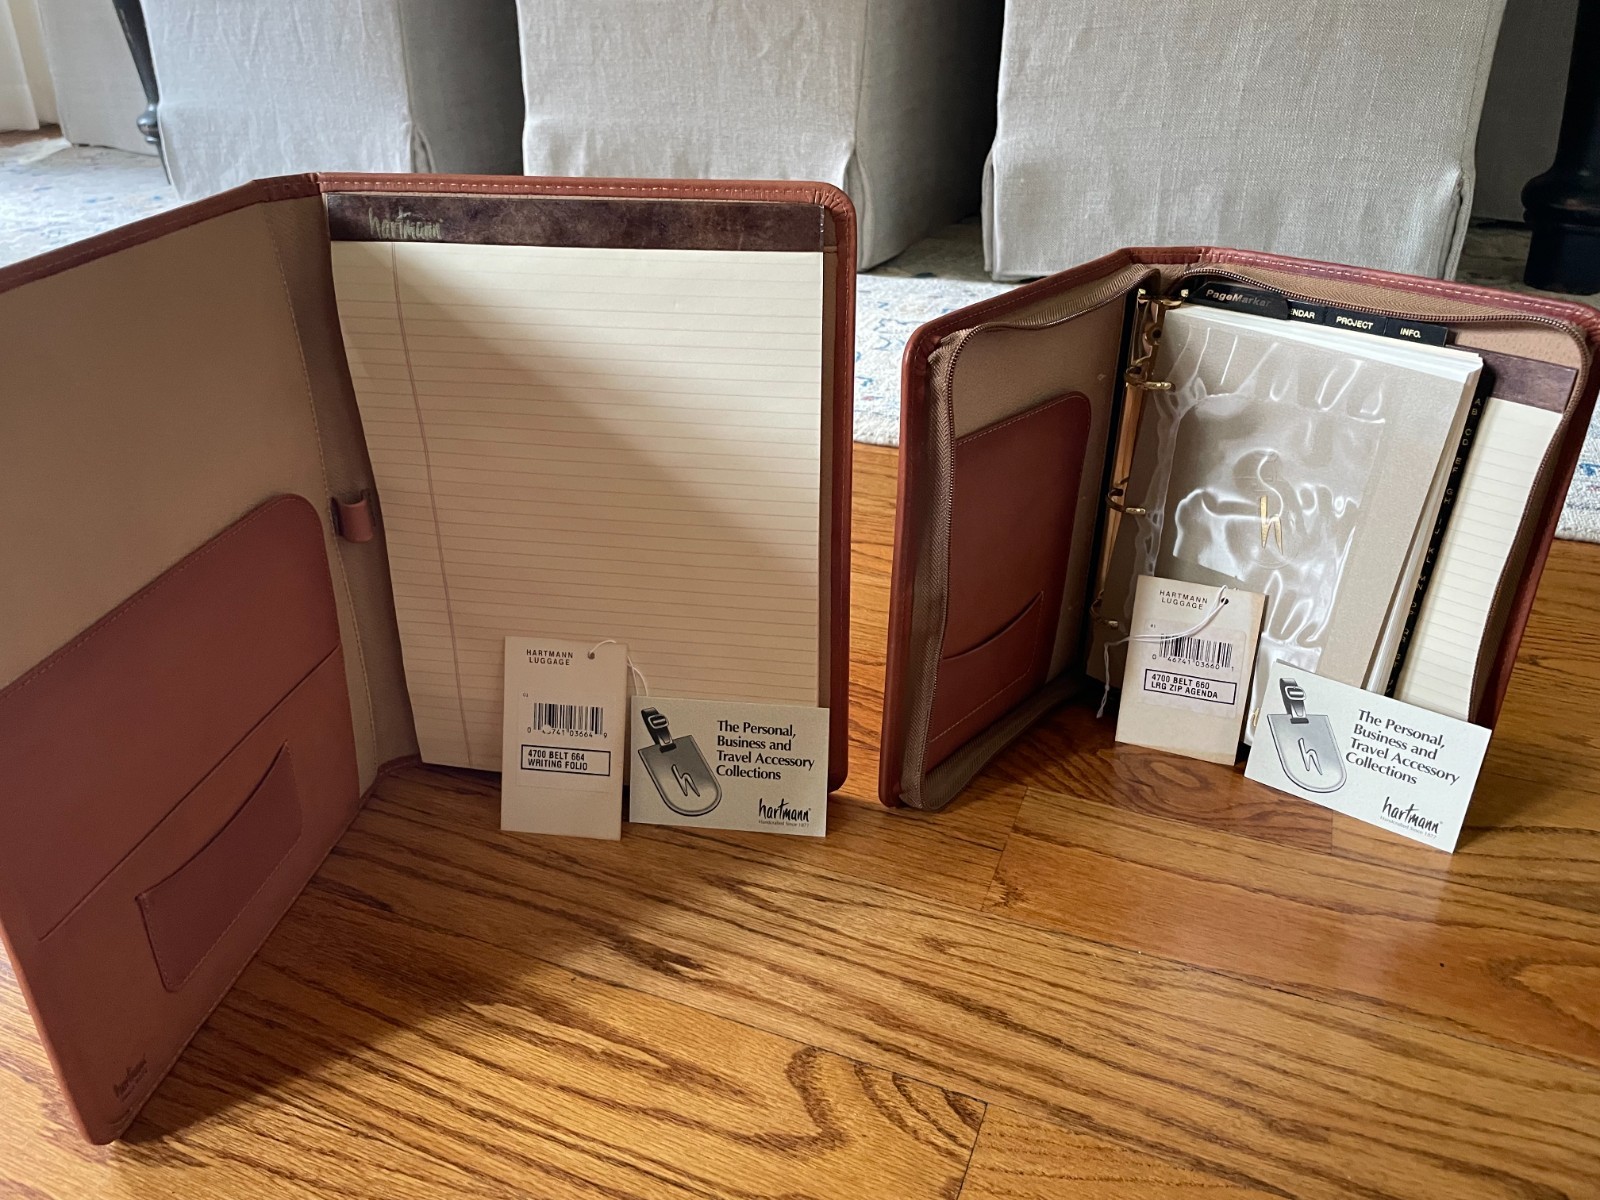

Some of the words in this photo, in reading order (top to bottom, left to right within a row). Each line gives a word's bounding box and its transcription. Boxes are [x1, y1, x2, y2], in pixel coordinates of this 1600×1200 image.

[1206, 289, 1272, 307] PageMarker
[1291, 308, 1316, 319] NDAR
[1336, 316, 1374, 330] PROJECT
[1400, 327, 1422, 338] INFO.
[1160, 589, 1208, 604] HARTMANN
[1161, 597, 1204, 611] LUGGAGE
[526, 649, 574, 659] HARTMANN
[529, 657, 570, 666] LUGGAGE
[1167, 656, 1191, 665] 46741
[1195, 660, 1220, 670] 03660
[1151, 673, 1171, 683] 4700
[1173, 676, 1193, 687] BELT
[1195, 680, 1210, 690] 660
[1151, 681, 1167, 691] LRG
[1169, 683, 1183, 693] ZIP
[1185, 687, 1219, 699] AGENDA
[569, 730, 593, 738] 03664
[717, 720, 740, 732] The
[743, 722, 796, 739] Personal,
[1358, 709, 1382, 727] The
[1385, 718, 1446, 749] Personal,
[717, 734, 766, 749] Business
[769, 739, 792, 751] and
[1353, 723, 1408, 751] Business
[1410, 744, 1438, 760] and
[528, 749, 547, 759] 4700
[549, 751, 568, 760] BELT
[571, 753, 585, 761] 664
[716, 750, 751, 764] Travel
[755, 753, 815, 771] Accessory
[1350, 736, 1389, 759] Travel
[1391, 752, 1461, 786] Accessory
[527, 758, 562, 769] WRITING
[565, 761, 588, 771] FOLIO
[716, 764, 781, 780] Collections
[1345, 752, 1418, 785] Collections
[758, 798, 810, 822] hartmann
[1381, 796, 1440, 834] hartmann
